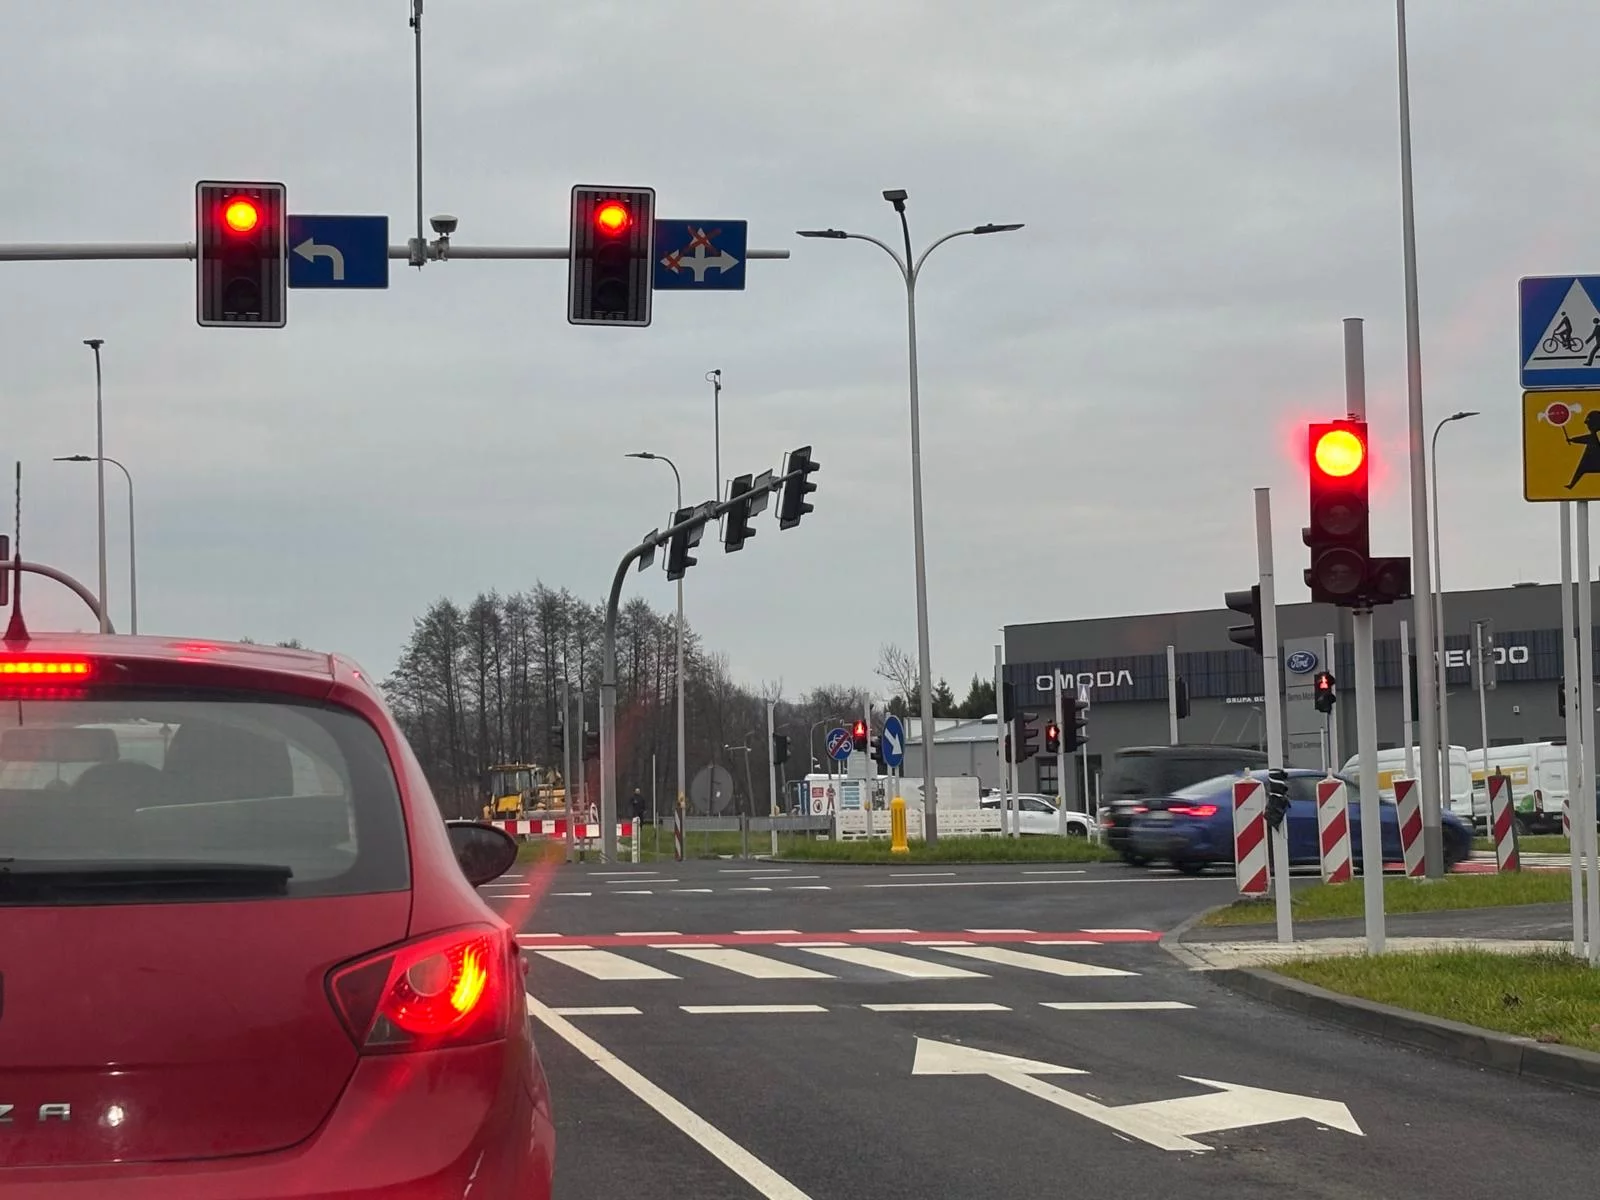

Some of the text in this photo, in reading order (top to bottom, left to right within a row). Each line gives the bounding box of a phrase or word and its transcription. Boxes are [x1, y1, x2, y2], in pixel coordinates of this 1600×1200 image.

[1290, 654, 1310, 669] Ford
[1434, 646, 1529, 668] EOO
[1036, 669, 1134, 691] OMODA
